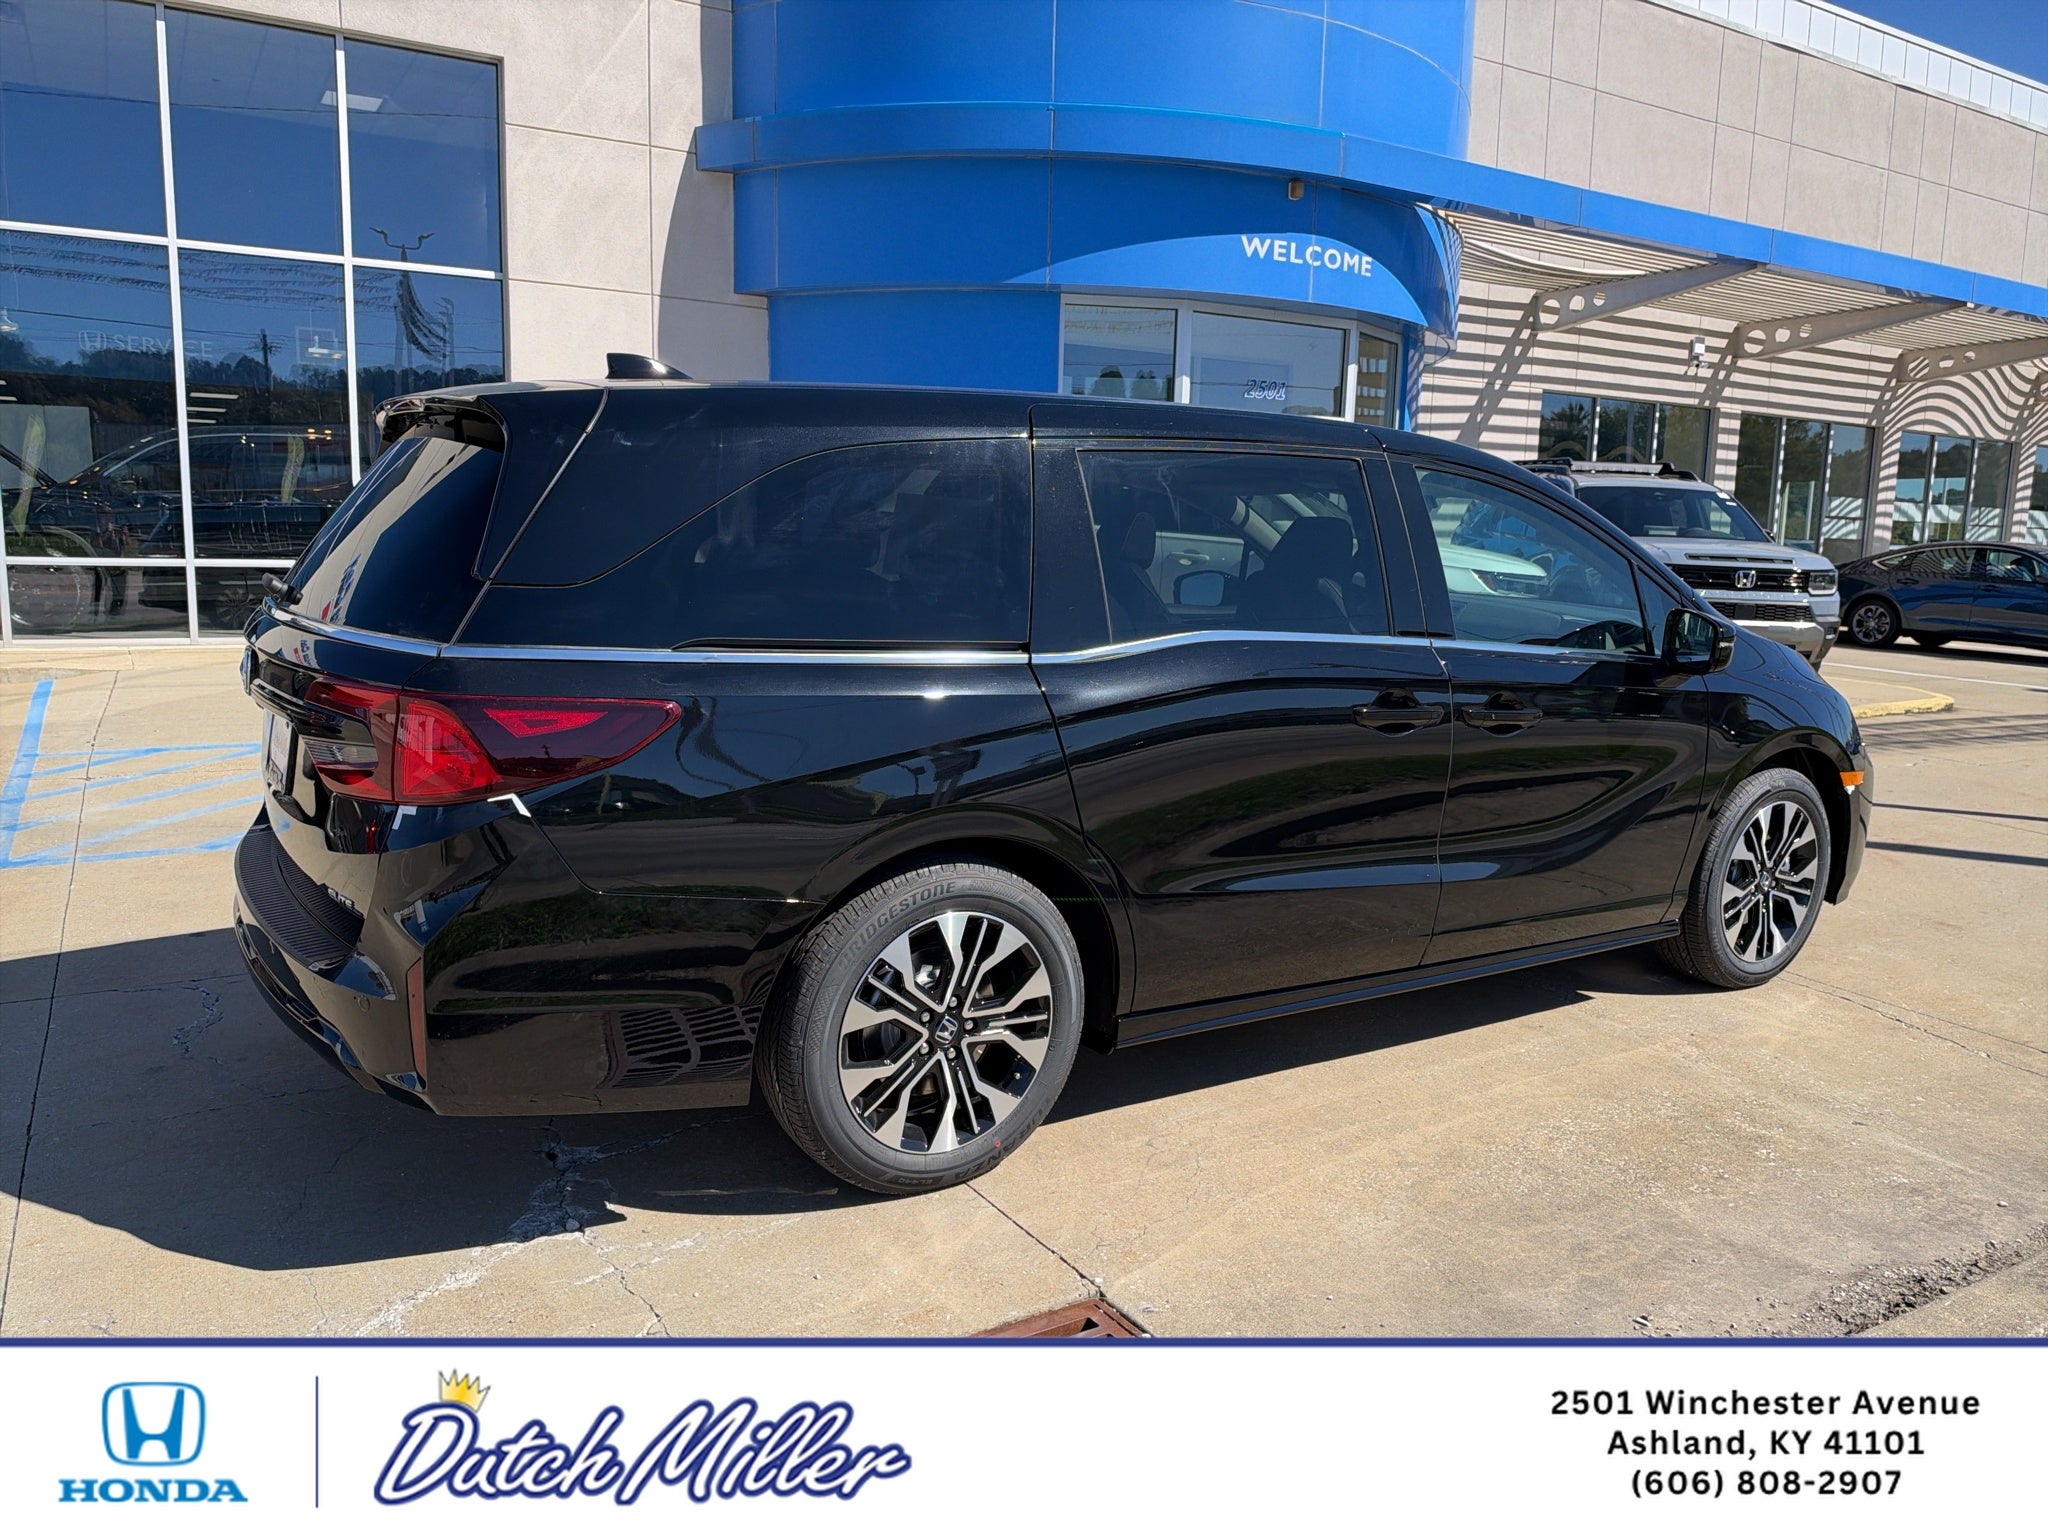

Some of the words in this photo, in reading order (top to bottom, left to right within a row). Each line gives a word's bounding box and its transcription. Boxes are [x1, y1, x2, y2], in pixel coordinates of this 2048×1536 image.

[1240, 234, 1373, 277] WELCOME
[113, 333, 213, 358] SERVCE
[1243, 377, 1287, 401] 2501
